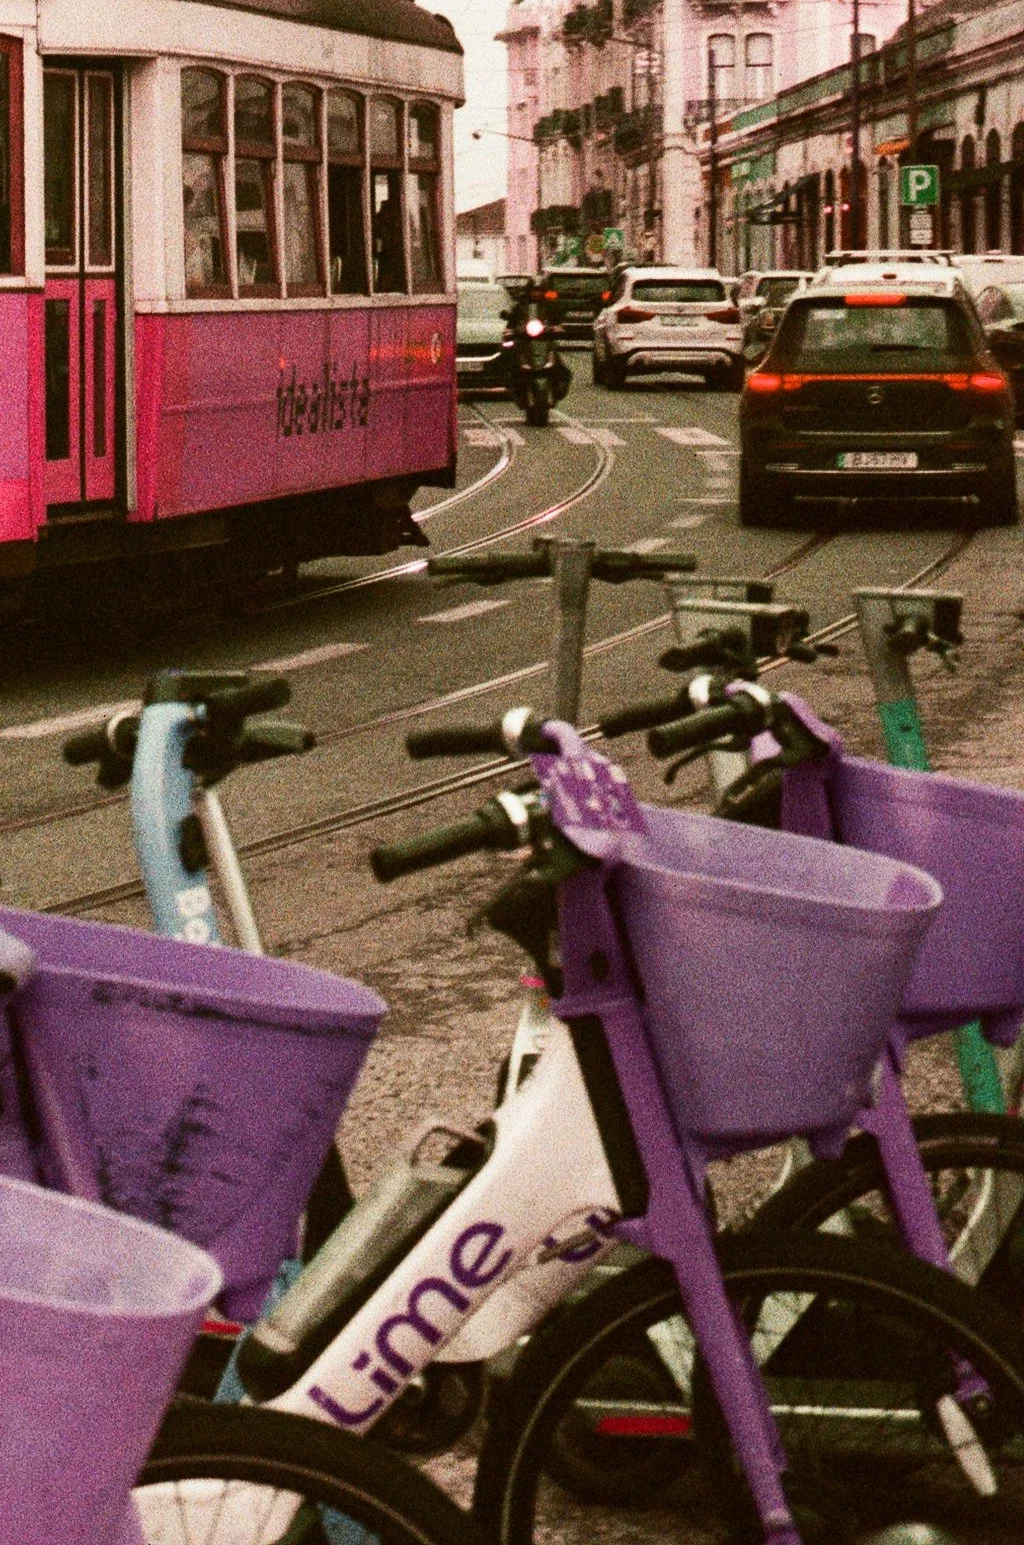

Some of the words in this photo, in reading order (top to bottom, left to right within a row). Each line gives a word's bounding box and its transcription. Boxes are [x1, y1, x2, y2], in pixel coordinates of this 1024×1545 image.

[908, 170, 932, 202] P
[275, 359, 371, 437] idealista
[308, 1220, 513, 1427] Lime
